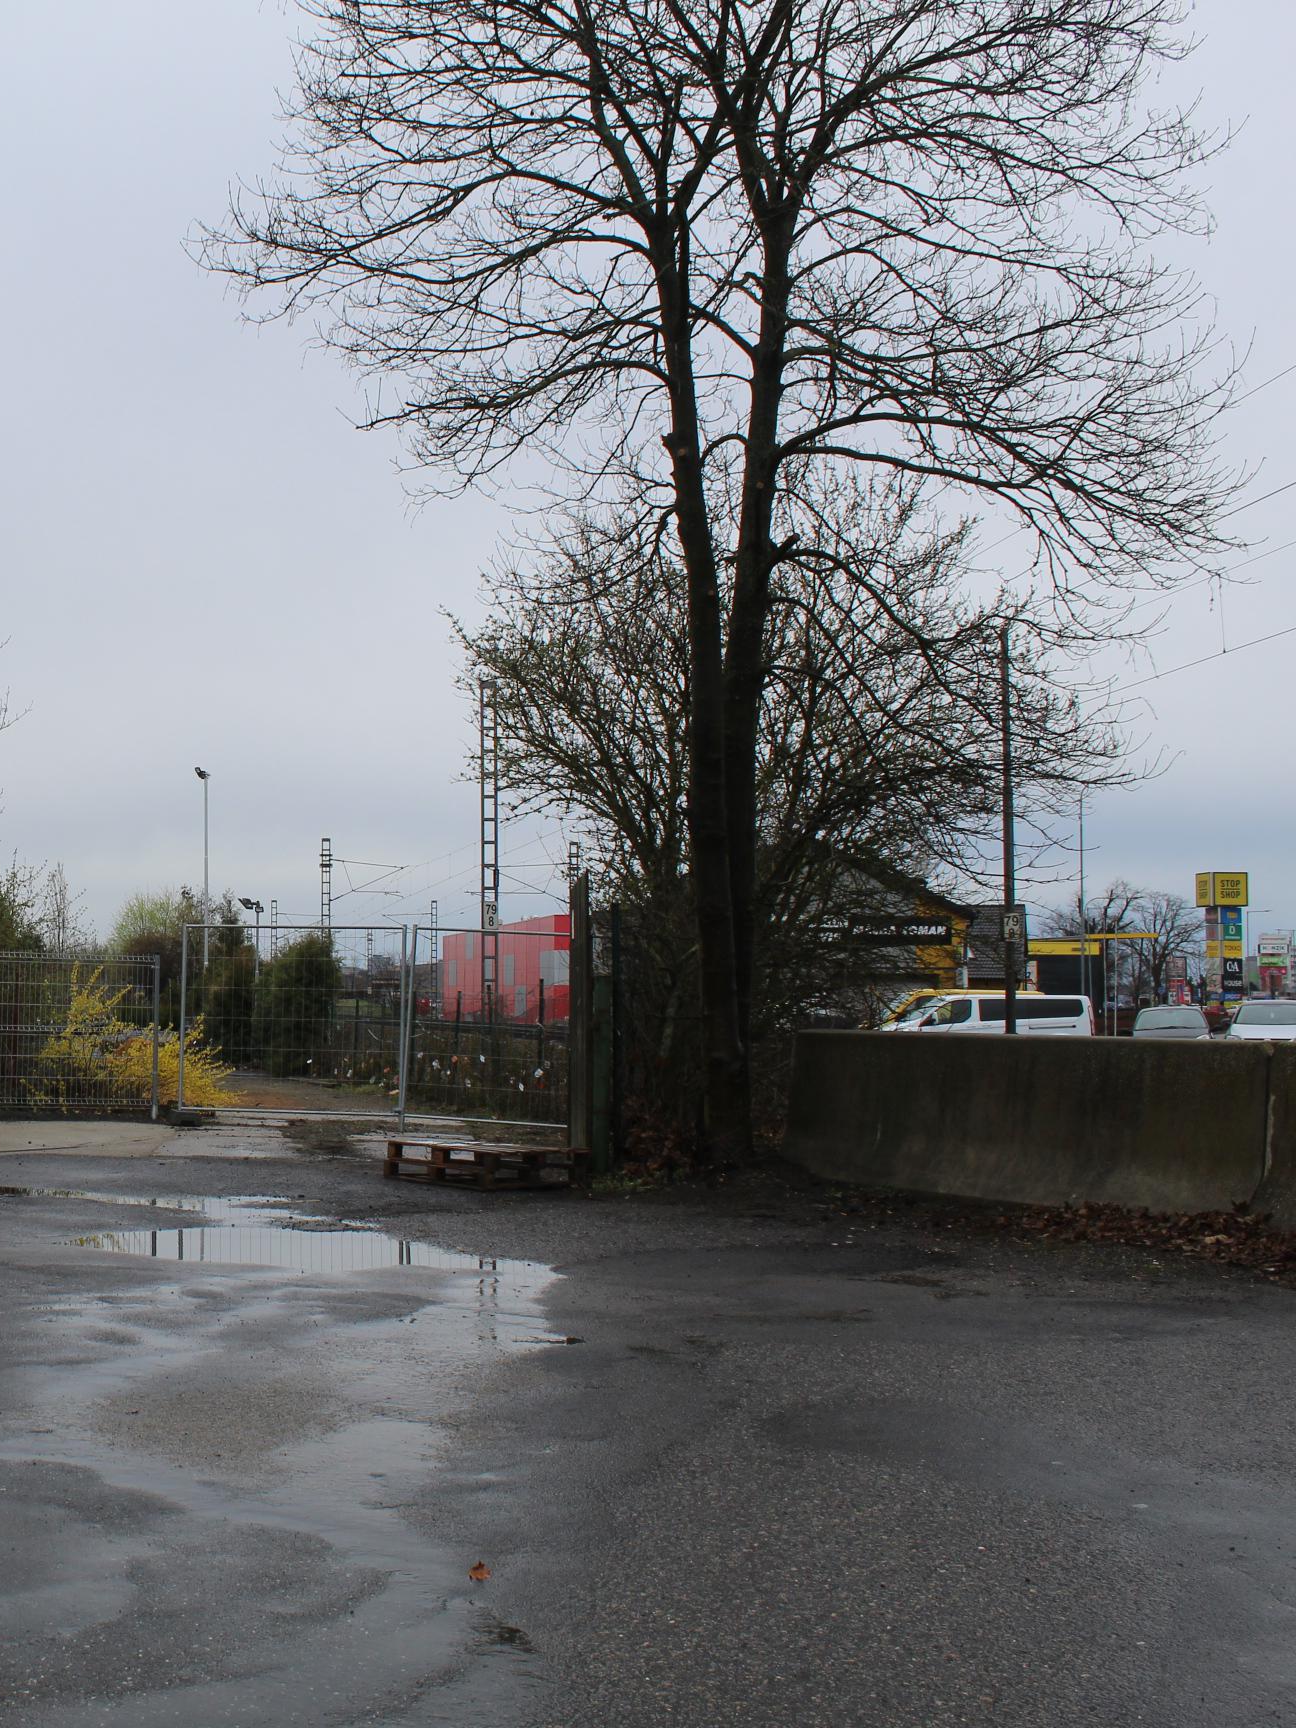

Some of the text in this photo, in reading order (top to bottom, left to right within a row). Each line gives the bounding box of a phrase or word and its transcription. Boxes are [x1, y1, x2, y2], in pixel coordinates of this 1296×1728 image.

[1220, 879, 1241, 888] STOP
[1220, 891, 1241, 899] SHOP
[485, 904, 497, 915] 79
[488, 916, 494, 927] 8
[1004, 915, 1019, 926] 79
